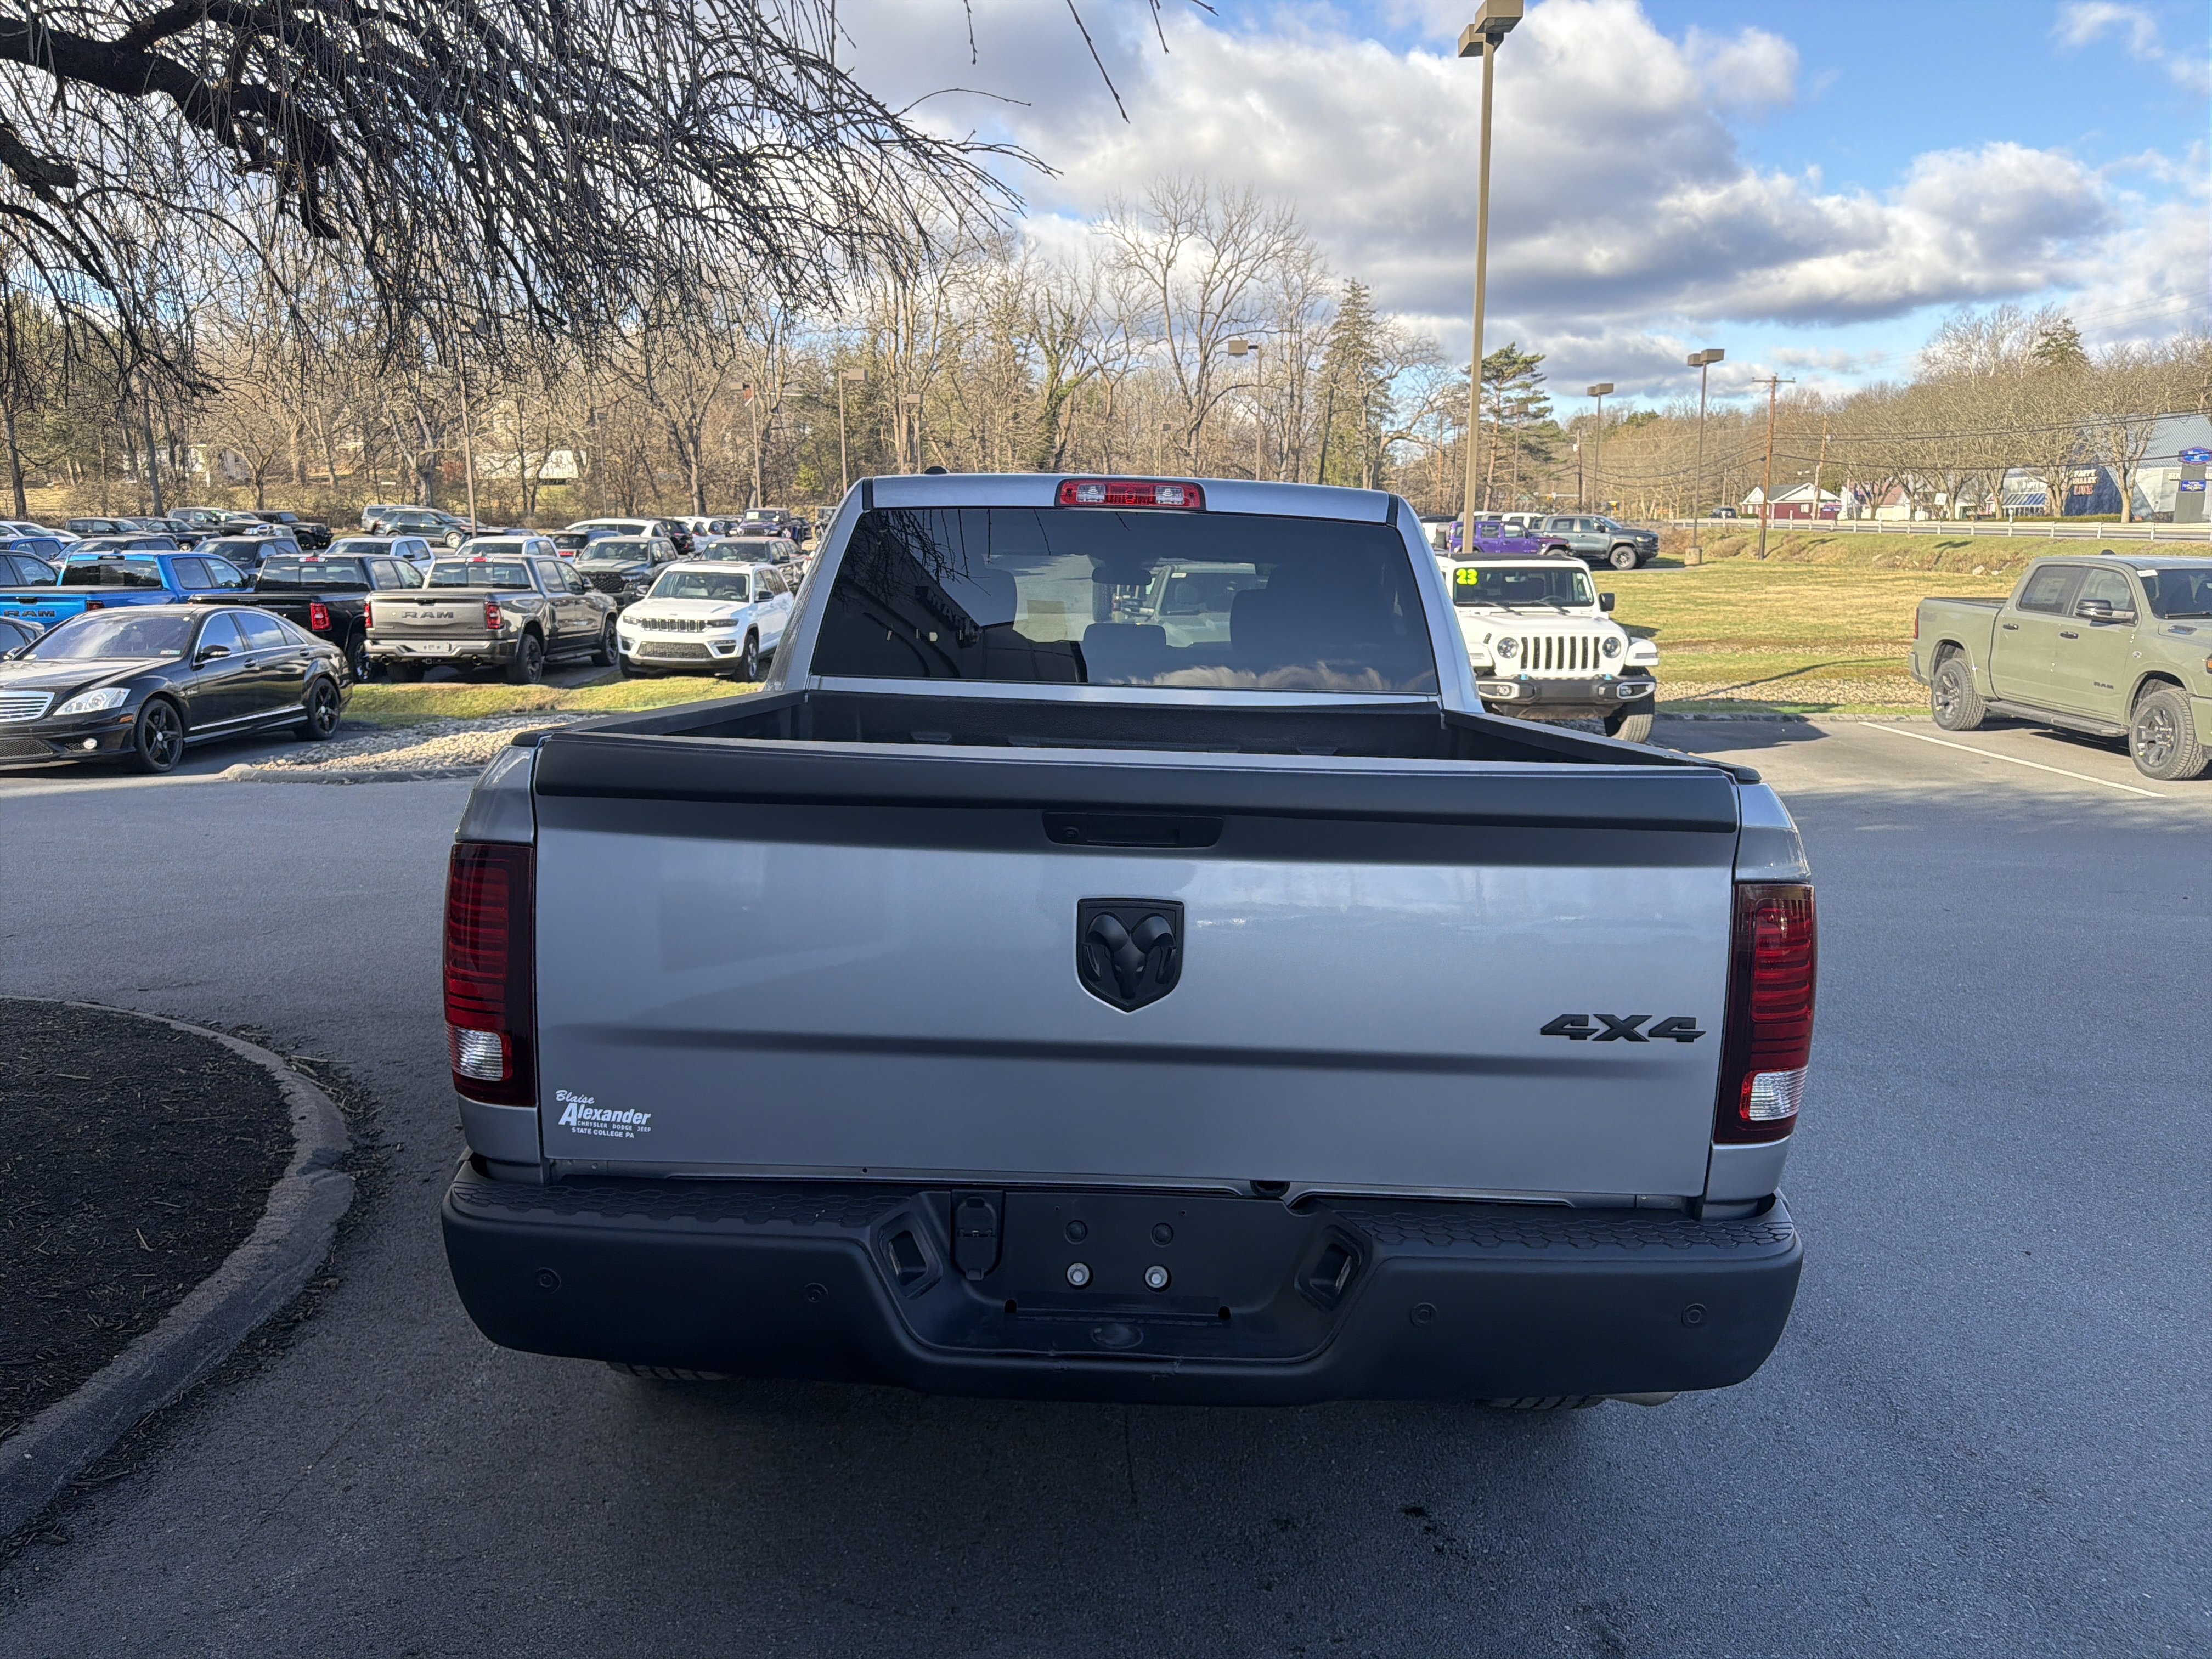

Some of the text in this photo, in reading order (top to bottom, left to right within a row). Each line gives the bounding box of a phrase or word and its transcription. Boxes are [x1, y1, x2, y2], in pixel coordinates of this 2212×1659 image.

[1456, 568, 1478, 585] 23
[401, 611, 454, 619] RAM
[2094, 681, 2114, 690] RAM
[555, 1090, 595, 1104] Blaise
[558, 1103, 652, 1126] Alexander
[577, 1120, 608, 1129] CHRYSLER
[571, 1127, 592, 1135] STATE
[593, 1128, 624, 1138] COLLEGE
